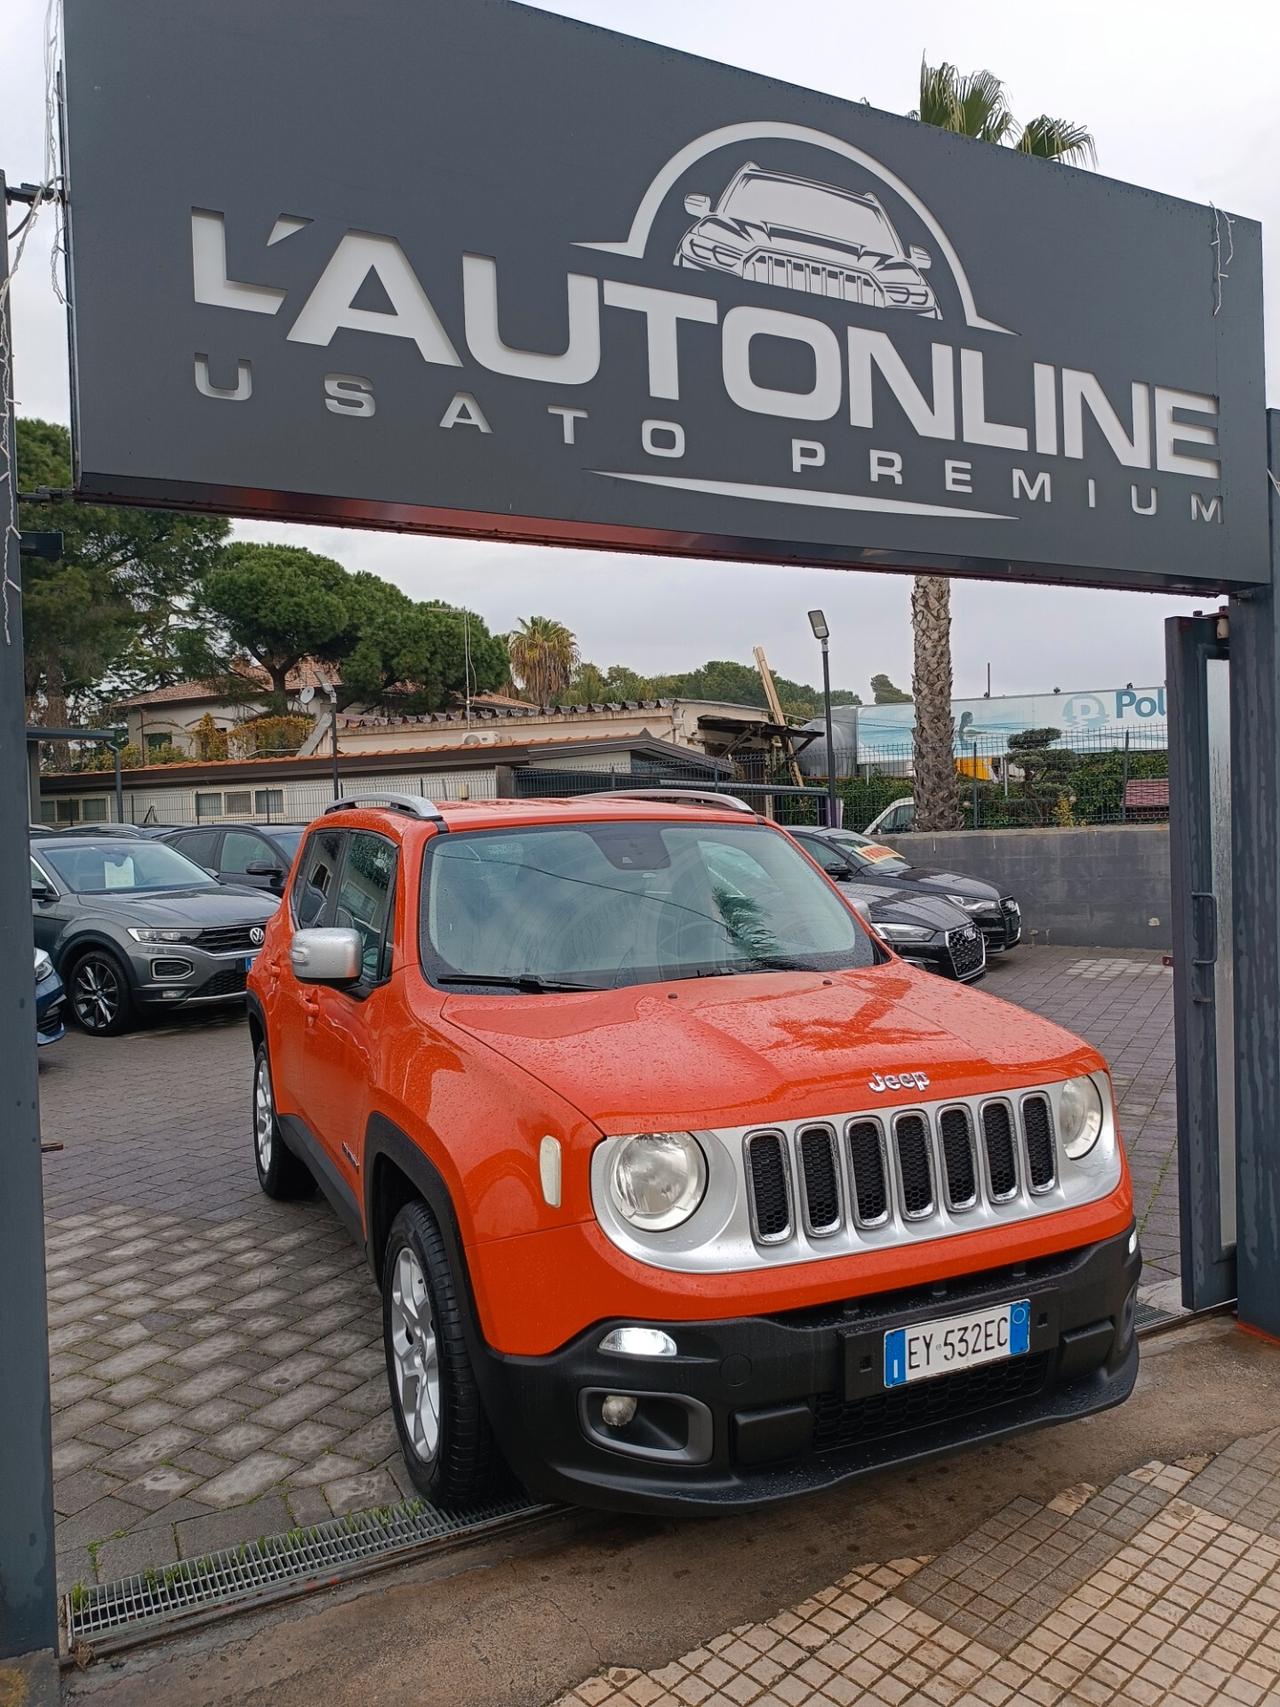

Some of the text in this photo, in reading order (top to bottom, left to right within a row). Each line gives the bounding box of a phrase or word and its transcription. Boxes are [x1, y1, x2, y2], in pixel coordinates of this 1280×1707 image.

[191, 206, 1220, 480] L'AUTONLINE
[194, 353, 1224, 525] USATO PREMIUM
[868, 1071, 931, 1093] Jeep
